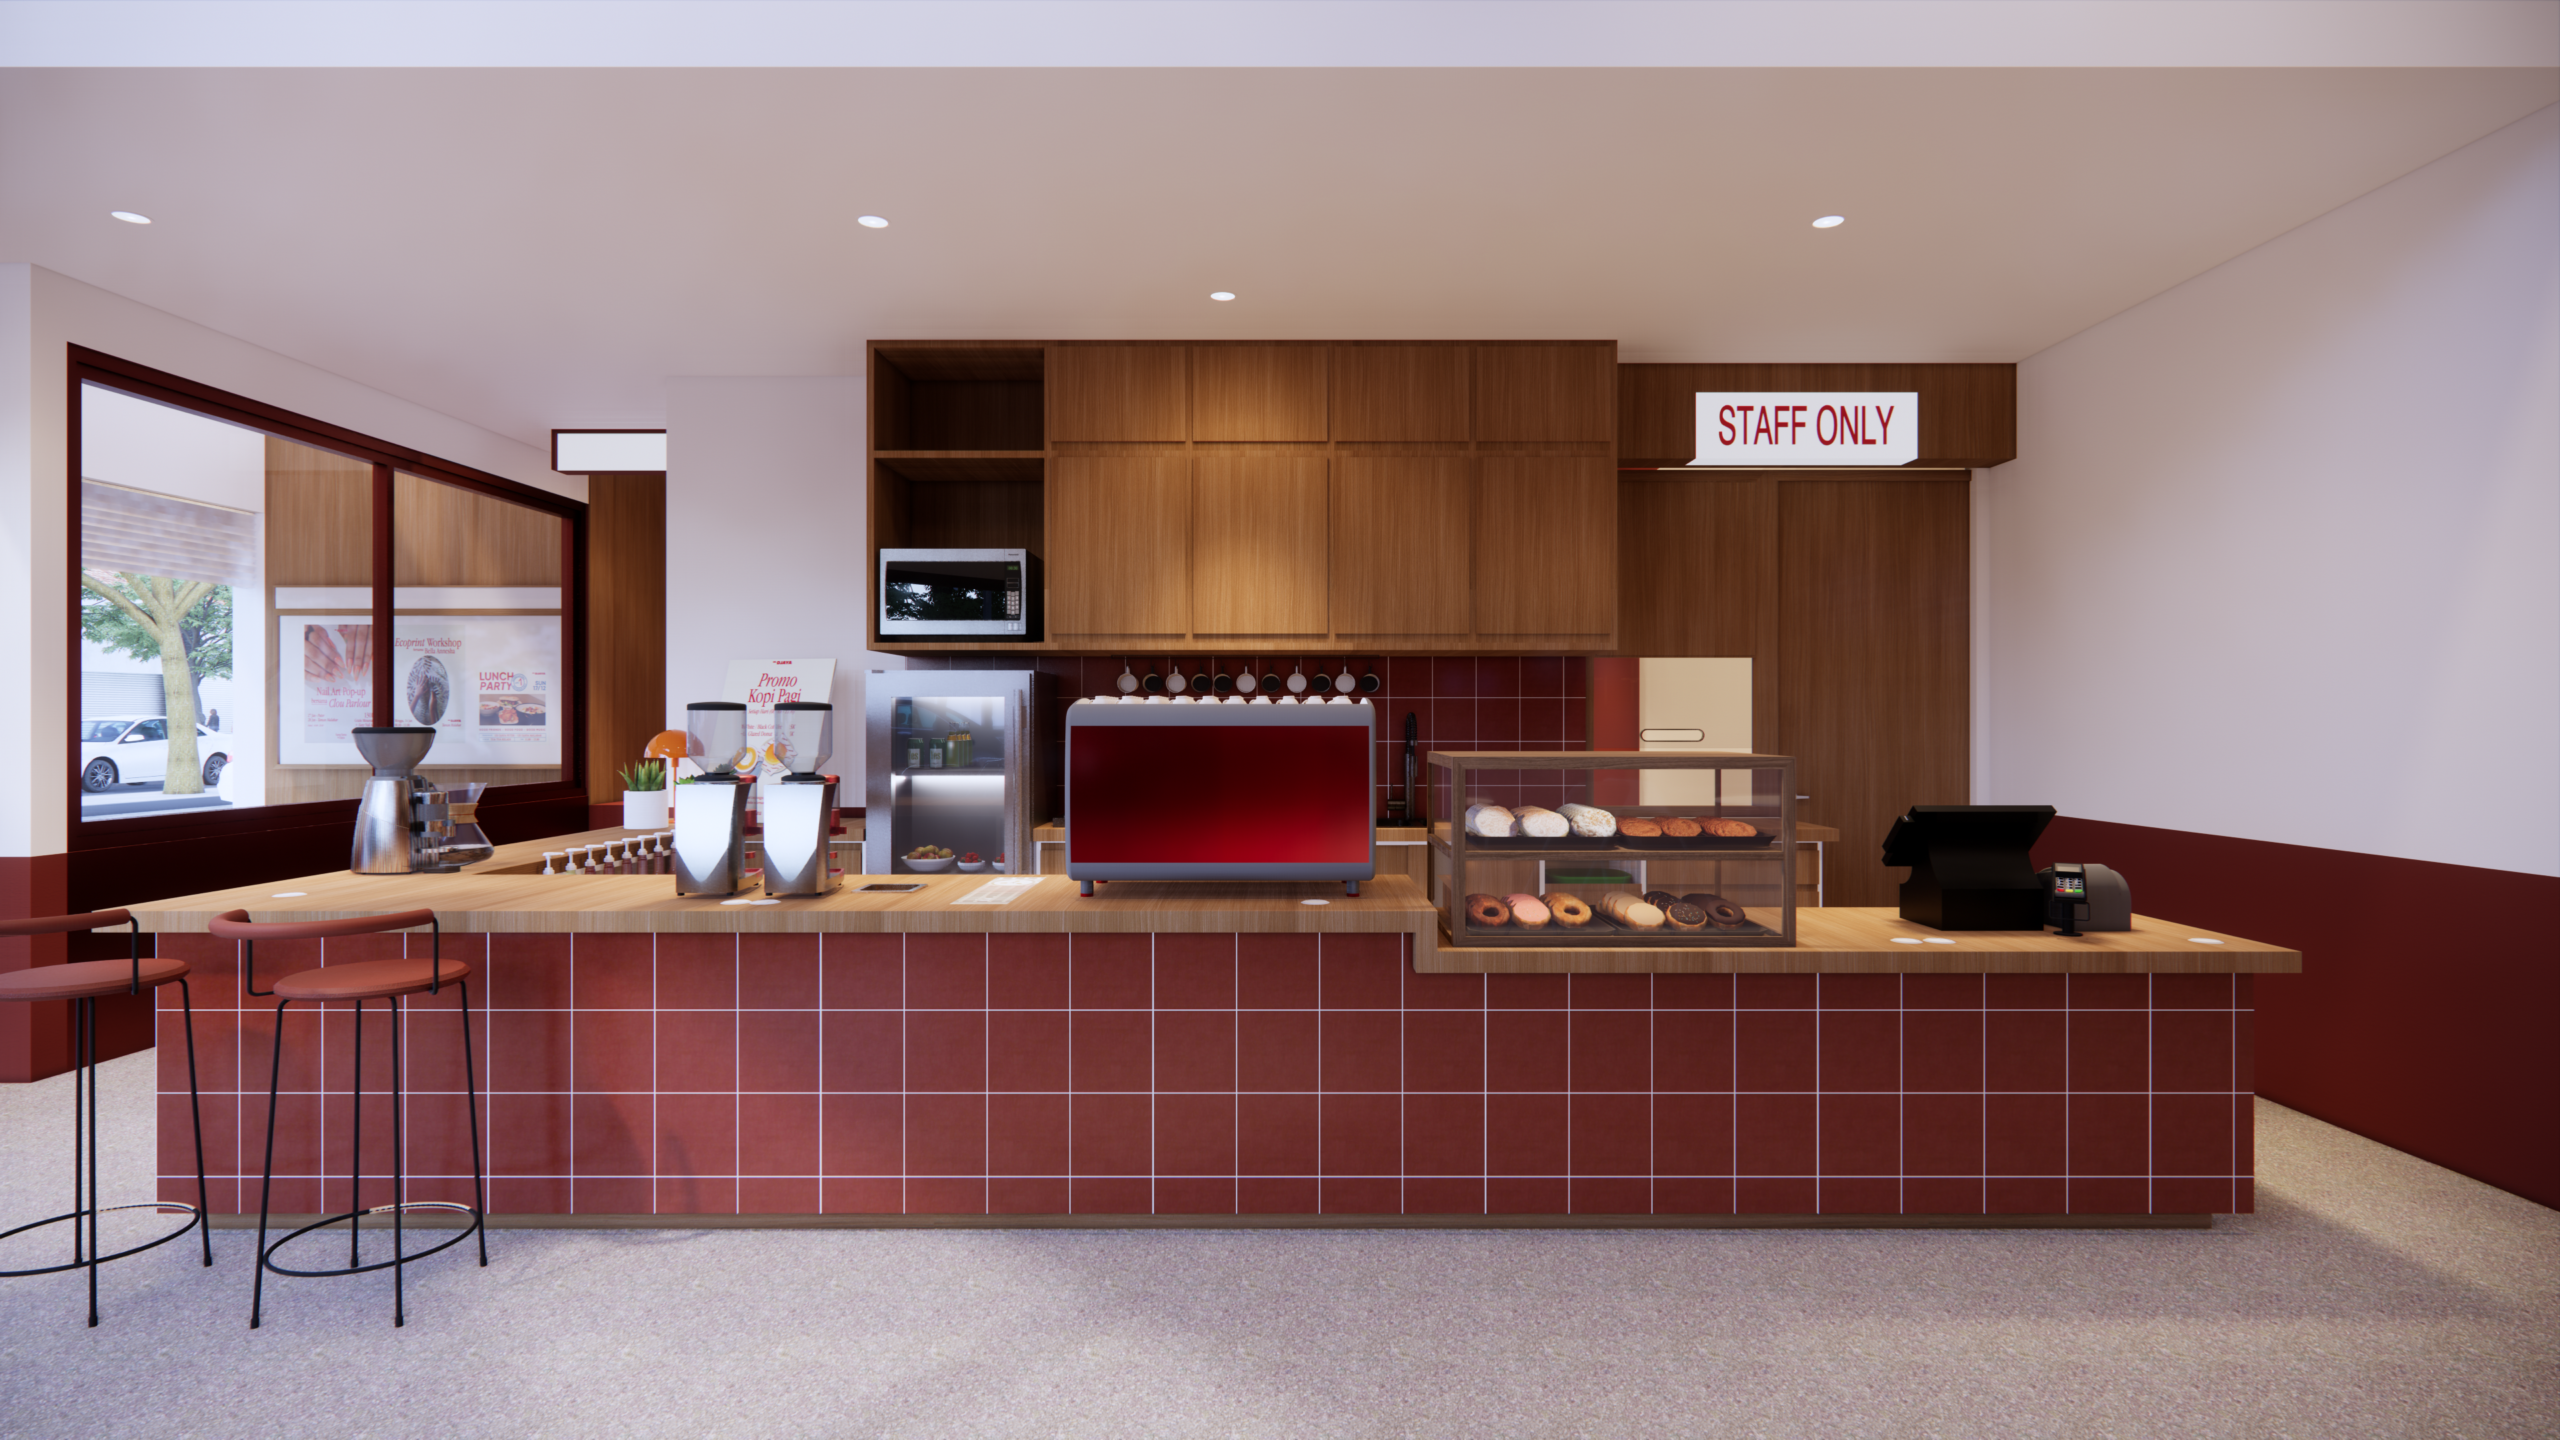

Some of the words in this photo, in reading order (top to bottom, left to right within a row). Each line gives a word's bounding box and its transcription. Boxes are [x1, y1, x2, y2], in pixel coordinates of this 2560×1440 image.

[1719, 405, 1807, 446] STAFF
[1816, 405, 1895, 446] ONLY
[395, 638, 425, 650] Ecoprint
[427, 637, 462, 650] Workshop
[479, 672, 514, 681] LUNCH
[758, 673, 798, 687] Promo
[316, 687, 330, 696] Nail
[331, 688, 342, 696] Art
[342, 687, 367, 698] Pop-up
[479, 682, 512, 691] PARTY
[329, 699, 345, 708] Clou
[346, 699, 372, 708] Parlour
[748, 689, 776, 708] Kopi
[778, 689, 802, 703] Pagi
